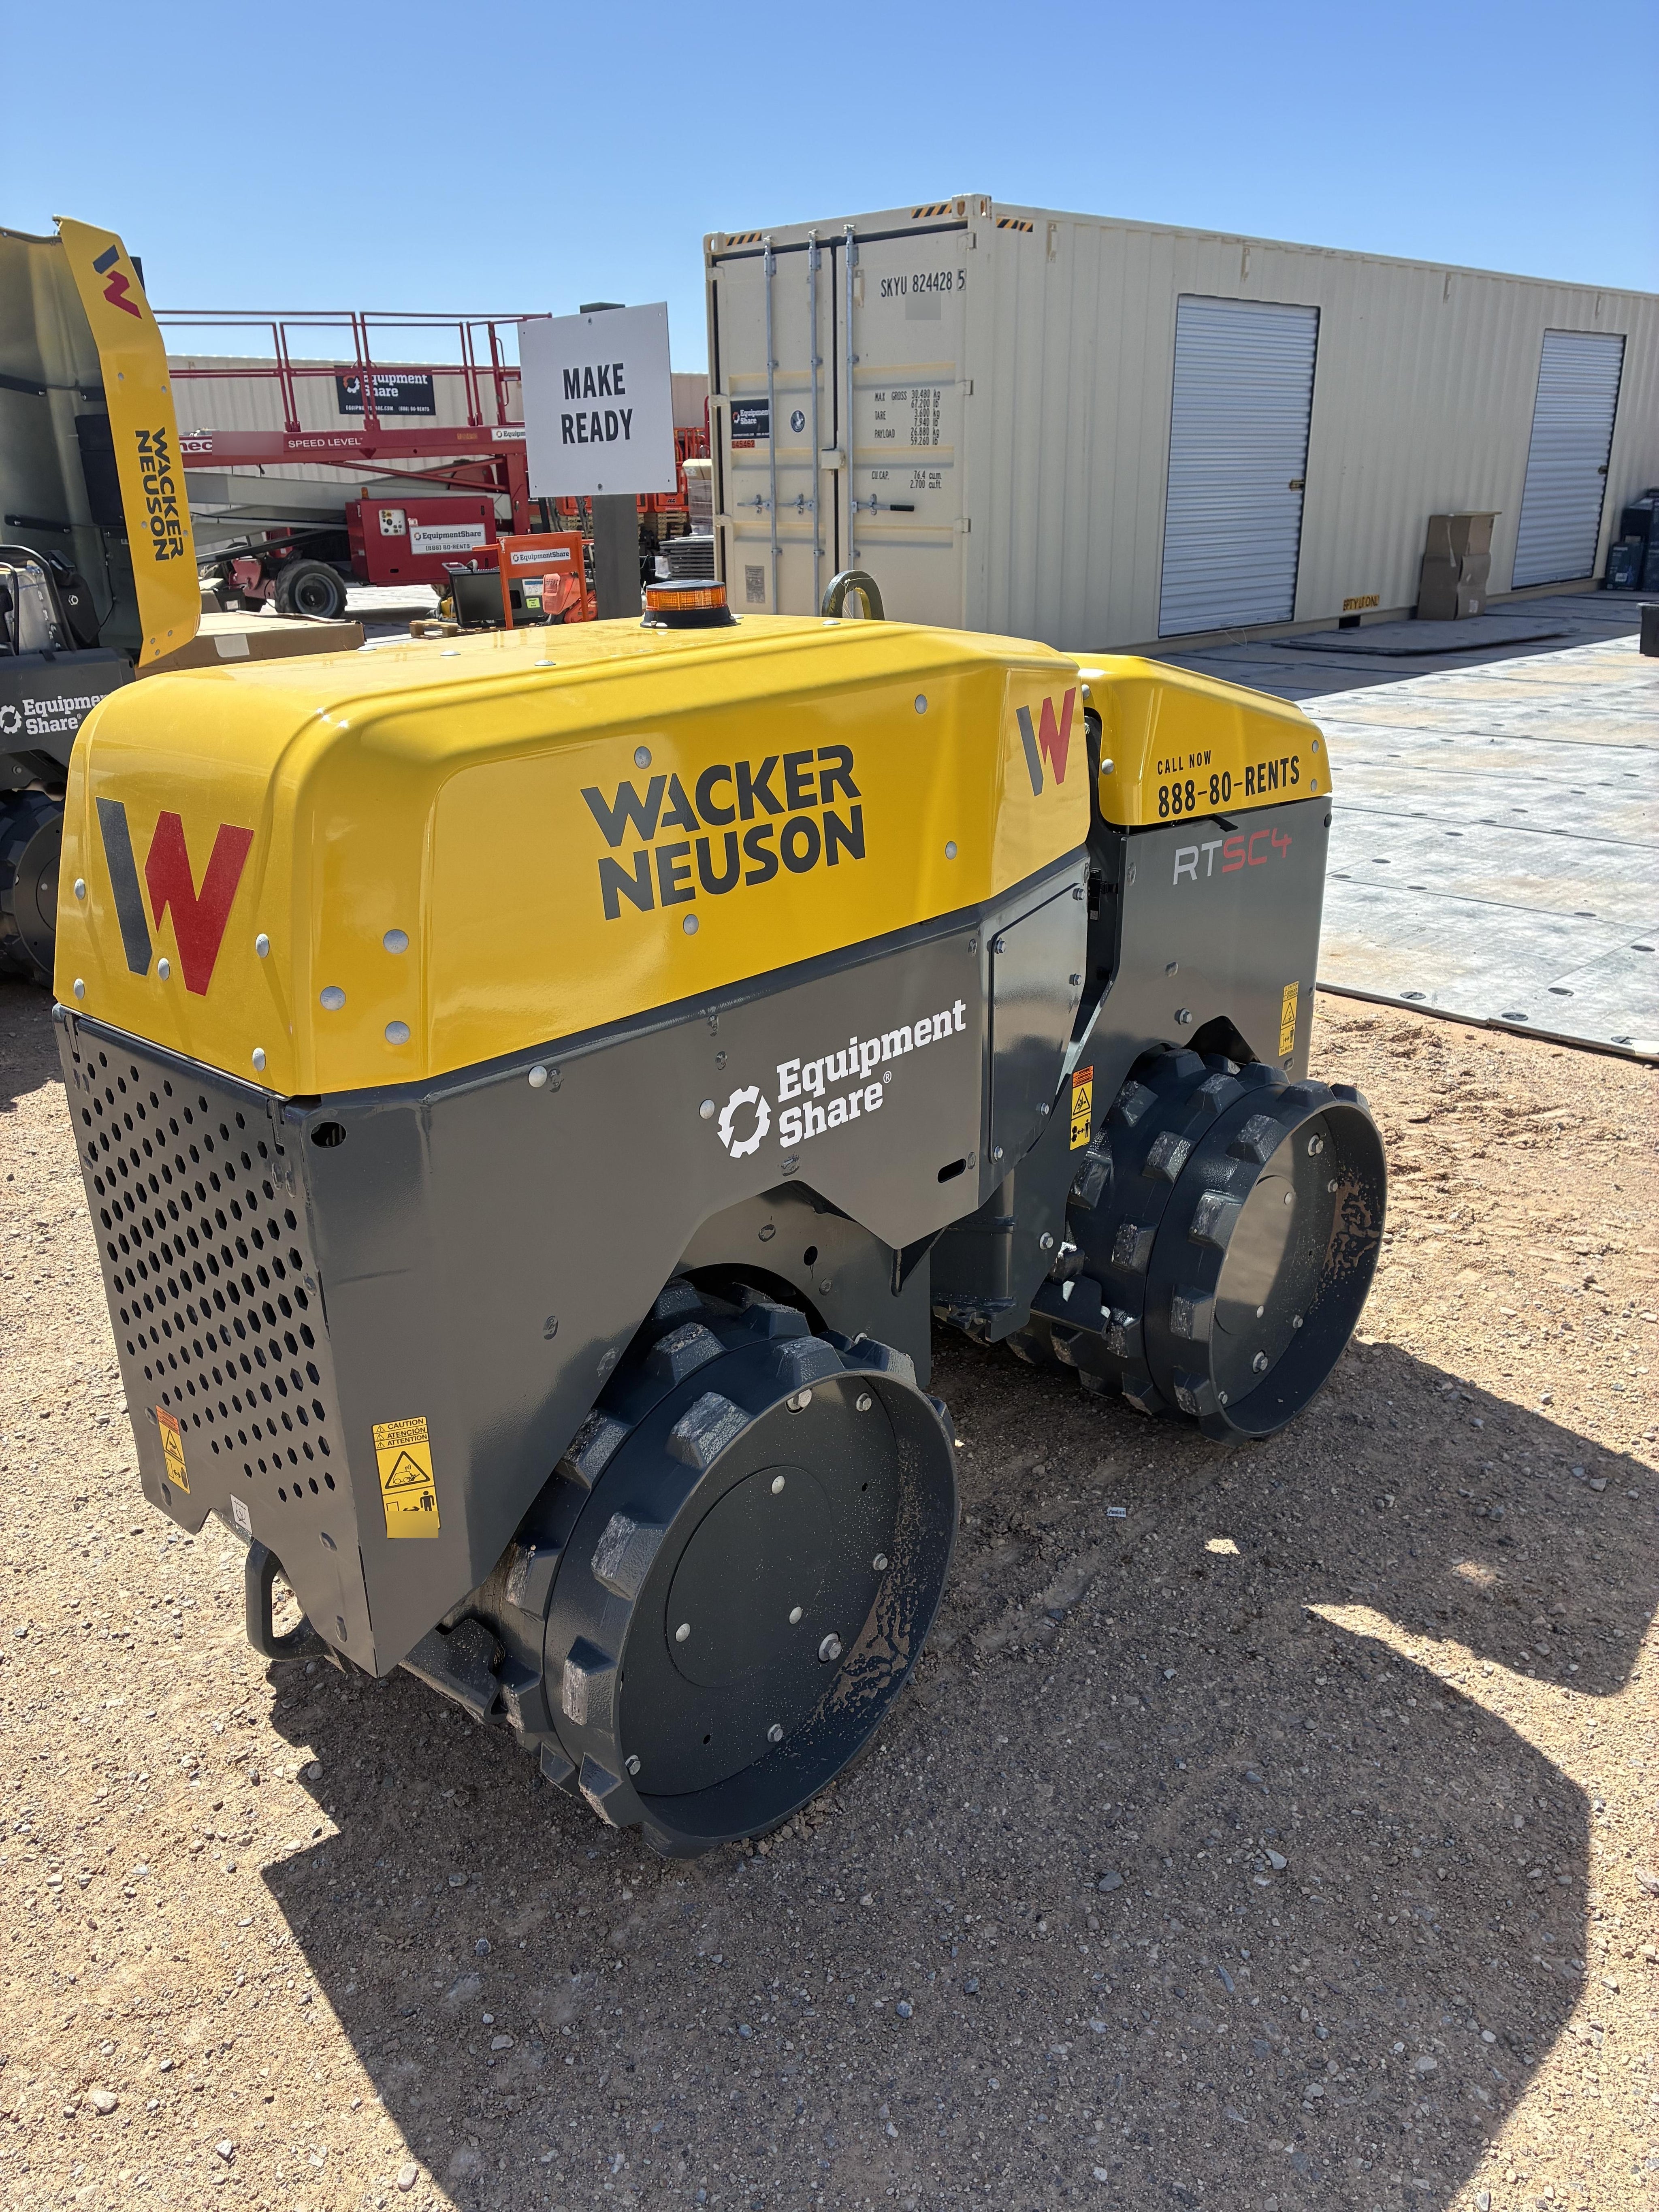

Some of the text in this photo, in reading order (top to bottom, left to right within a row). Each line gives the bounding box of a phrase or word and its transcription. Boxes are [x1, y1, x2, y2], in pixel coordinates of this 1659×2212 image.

[881, 270, 965, 297] SKYU 824428 5
[563, 363, 625, 400] MAKE
[875, 389, 940, 401] MAX GROSS 30.480 kg
[911, 399, 939, 408] 67.200 lb
[875, 408, 940, 420] TARE 3.600 kg
[561, 408, 633, 444] READY
[914, 418, 938, 427] 7.940 lb
[874, 427, 940, 438] PAYLOAD 26.880 kg
[288, 439, 324, 448] SPEED
[911, 436, 938, 445] 59.260 lb
[914, 470, 925, 479] 76.4
[910, 480, 925, 488] 2.700
[135, 431, 169, 561] NEUSON
[152, 427, 183, 559] WACKER
[422, 531, 481, 540] EquipmentShare
[520, 551, 569, 561] EquipmentShare
[1157, 750, 1211, 775] CALL NOW
[1159, 755, 1299, 818] 888-80-RENTS
[580, 745, 861, 847] WACKER
[598, 804, 866, 920] NEUSON
[1173, 828, 1292, 885] RTSC4
[776, 999, 966, 1103] Equipment
[388, 1418, 424, 1430] CAUTION
[387, 1427, 426, 1439] ATENCIÓN
[387, 1434, 427, 1446] ATTENTION
